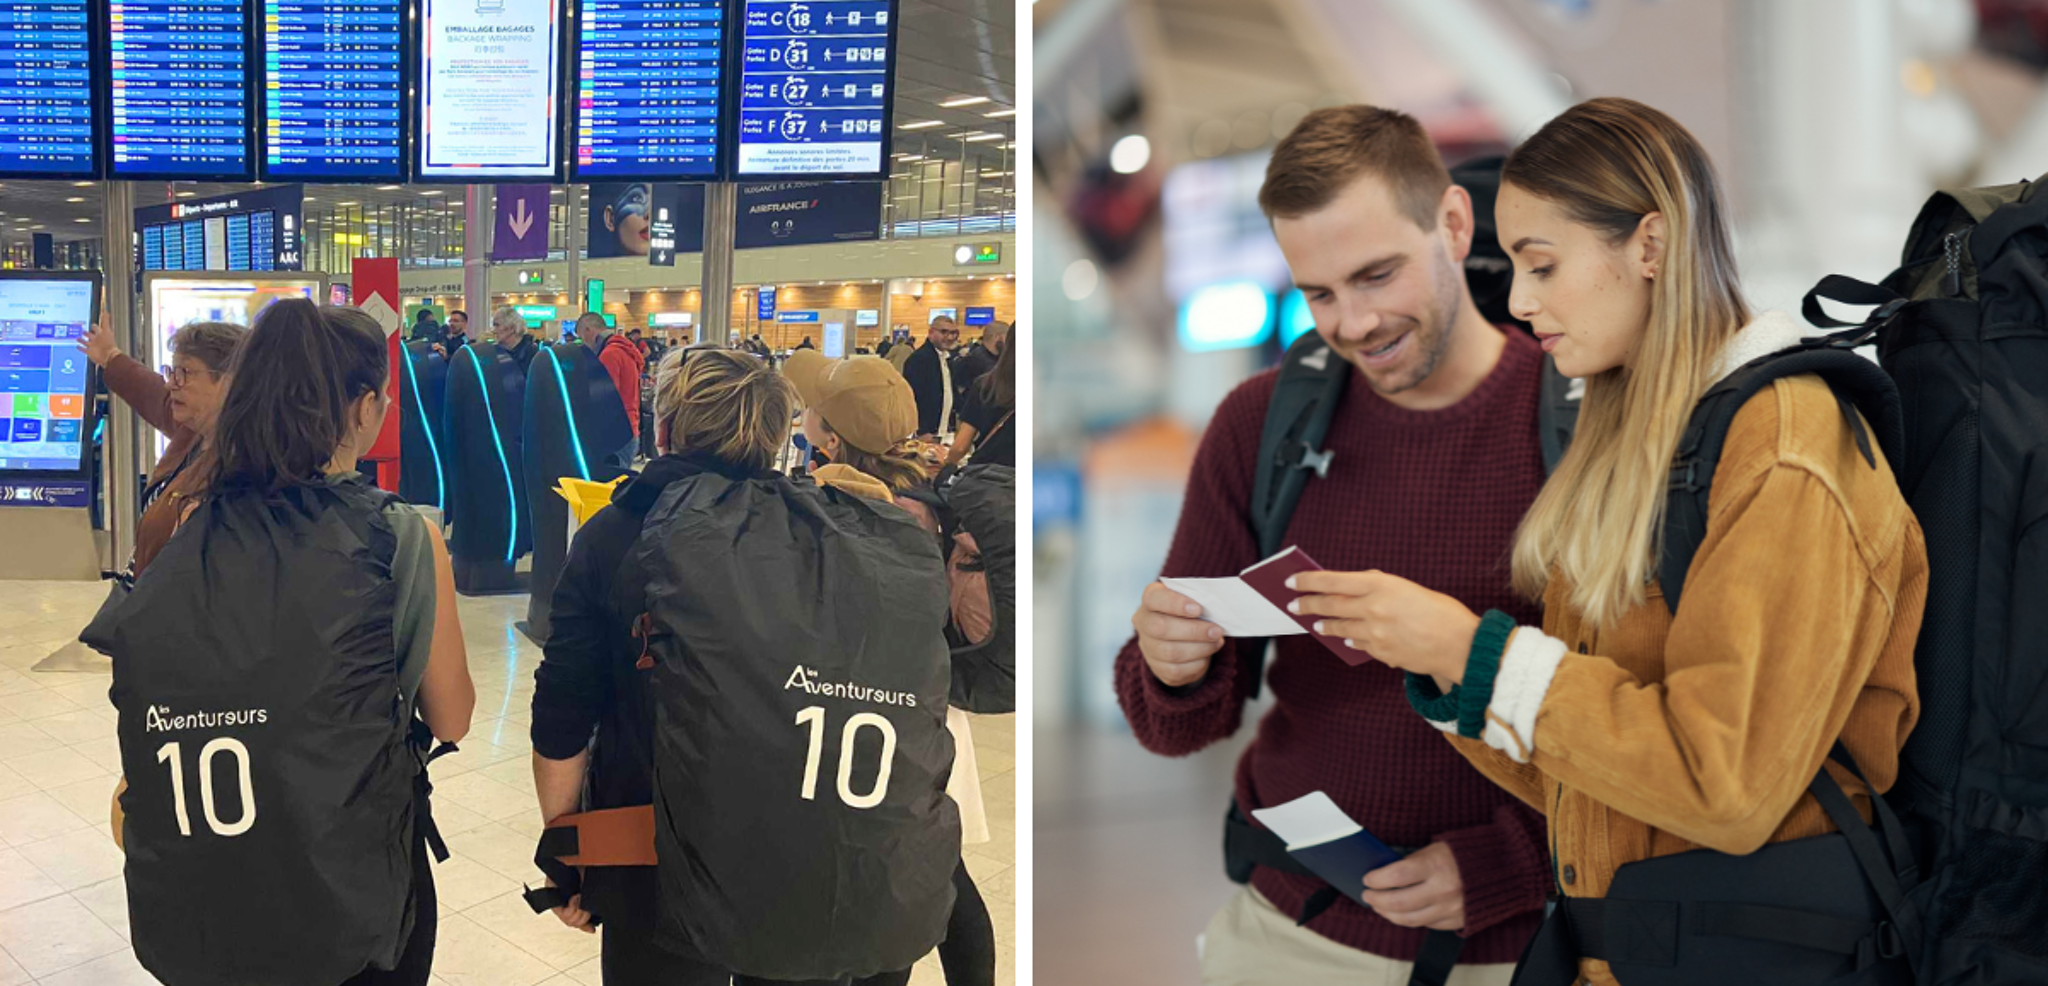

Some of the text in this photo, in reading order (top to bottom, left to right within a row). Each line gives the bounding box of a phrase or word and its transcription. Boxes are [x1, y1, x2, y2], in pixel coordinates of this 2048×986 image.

[771, 12, 810, 26] C 18
[445, 25, 535, 33] EMBALLAGE BAGAGES
[770, 48, 808, 63] D 31
[769, 84, 809, 98] E 27
[768, 120, 807, 134] F 37
[795, 705, 897, 809] 10
[156, 737, 256, 836] 10
